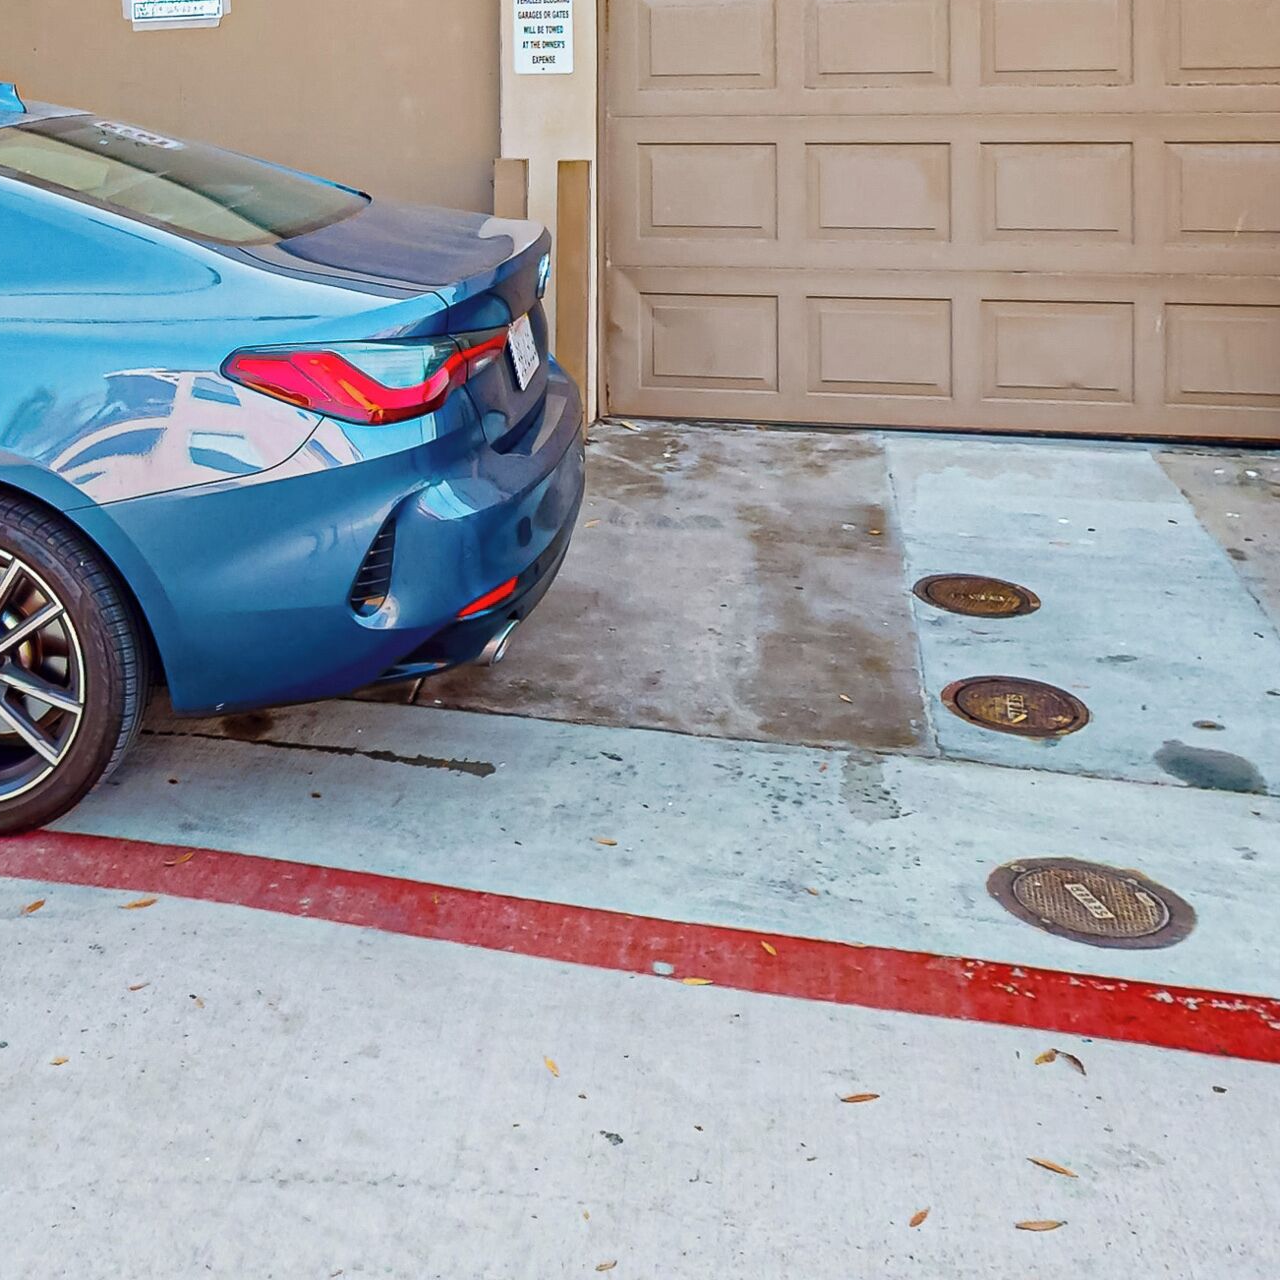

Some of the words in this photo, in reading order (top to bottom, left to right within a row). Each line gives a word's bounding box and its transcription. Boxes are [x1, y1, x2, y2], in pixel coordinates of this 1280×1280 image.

[518, 11, 542, 19] GARAGES
[544, 11, 551, 19] OR
[552, 10, 569, 19] GATES
[523, 25, 536, 34] WILL
[537, 25, 544, 34] BE
[546, 25, 563, 34] TOWED
[522, 41, 529, 49] AT
[542, 40, 565, 48] OWNER'S
[532, 55, 556, 64] EXPENSE
